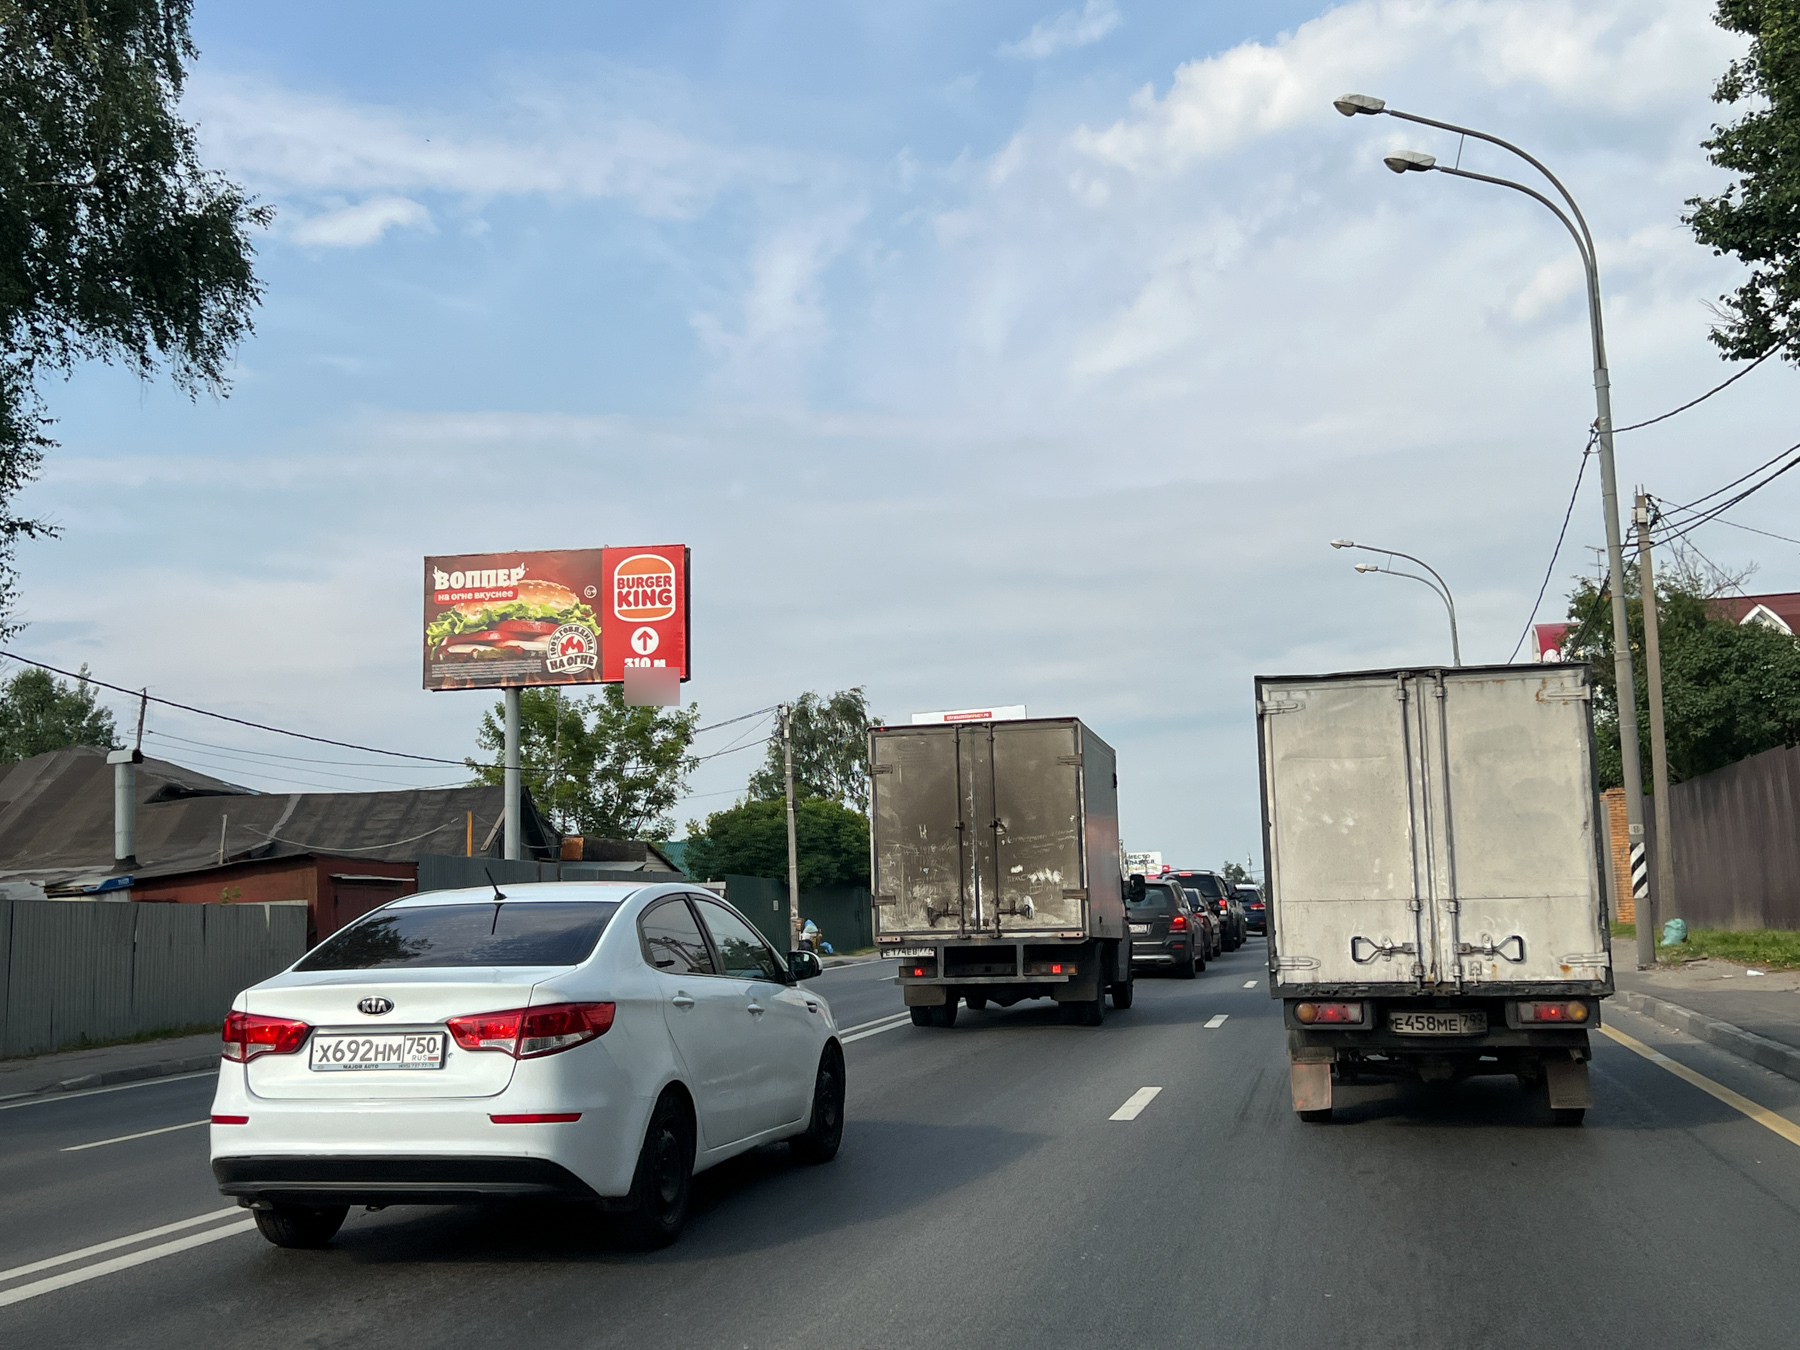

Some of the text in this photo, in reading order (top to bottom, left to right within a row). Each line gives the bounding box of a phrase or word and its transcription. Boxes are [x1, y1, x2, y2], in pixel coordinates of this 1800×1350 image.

[433, 563, 525, 590] ВОППЕР
[616, 575, 672, 590] BURGER
[451, 592, 473, 600] огне
[474, 590, 514, 601] вкуснее
[616, 588, 673, 608] KING
[550, 626, 594, 656] 100% ГОВЯДИНА
[550, 658, 566, 671] НА
[566, 654, 595, 667] ОГНЕ
[361, 997, 387, 1013] KIA
[1394, 1015, 1459, 1031] Е458МЕ
[318, 1037, 437, 1062] Х692НМ 750
